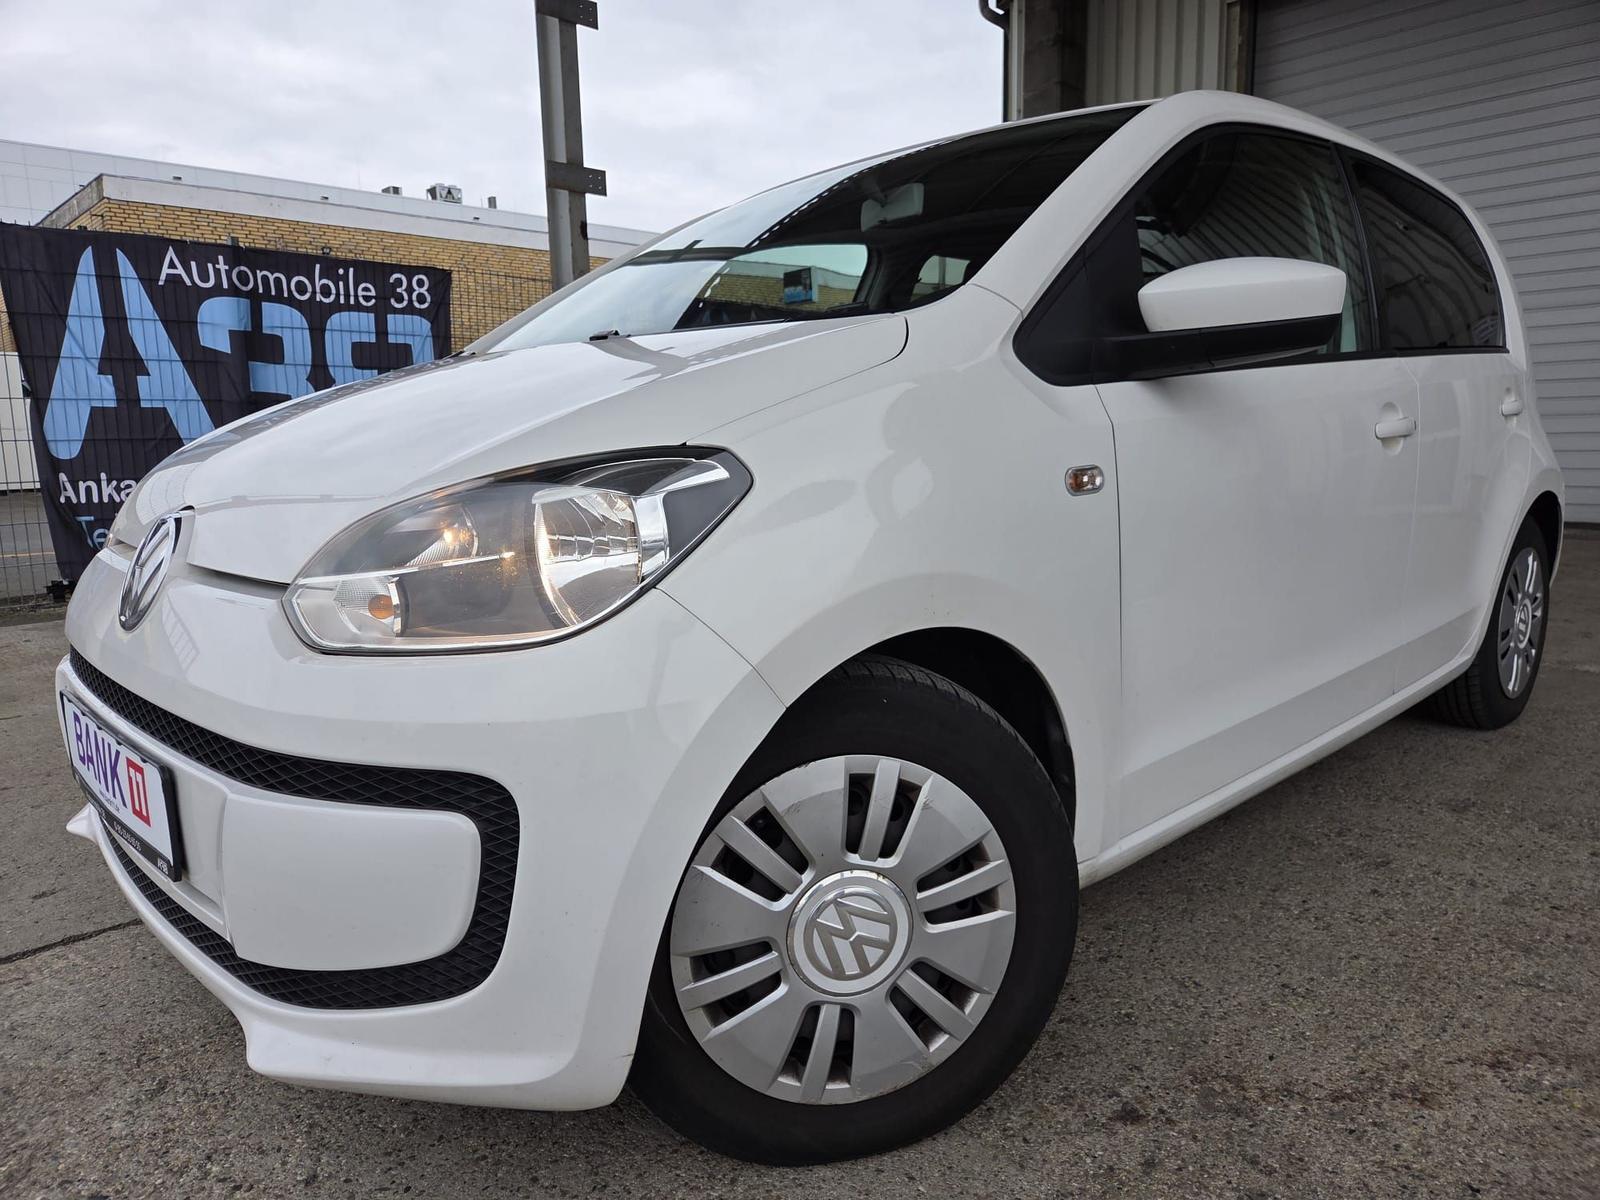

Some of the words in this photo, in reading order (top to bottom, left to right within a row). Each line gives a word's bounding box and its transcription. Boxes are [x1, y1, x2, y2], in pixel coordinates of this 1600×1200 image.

[157, 245, 377, 307] Automobile
[389, 272, 432, 310] 38
[75, 512, 117, 550] Te
[73, 710, 128, 809] BANK
